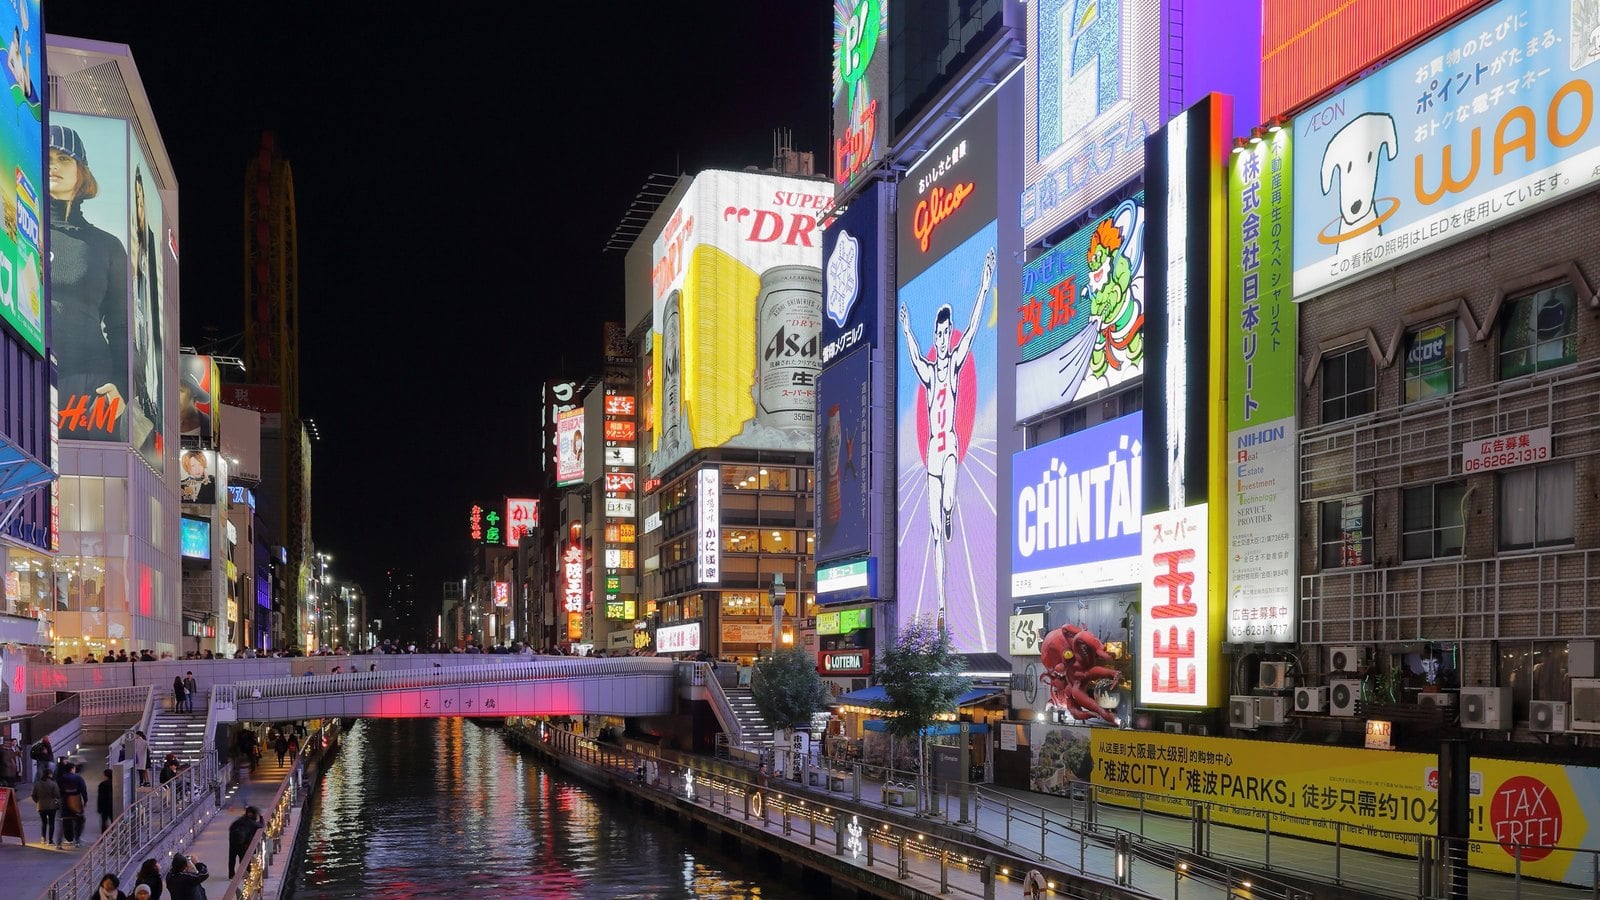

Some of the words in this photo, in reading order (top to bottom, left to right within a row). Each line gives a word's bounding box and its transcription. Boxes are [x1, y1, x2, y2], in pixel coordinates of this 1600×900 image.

[1415, 11, 1528, 84] お買物のたびに
[1416, 29, 1563, 114] ポイントがたまる、
[1415, 68, 1551, 142] おトクな電子マネー
[836, 100, 876, 184] ピップ
[919, 140, 967, 194] おいしさと健康
[914, 183, 974, 252] Glico
[1330, 173, 1570, 276] この看板の照明はLEDを使用しています。
[1270, 141, 1282, 351] 不動産再生のスペシャリスト
[1024, 252, 1071, 294] かぜに
[1242, 153, 1260, 420] 株式会社日本リート
[1017, 275, 1077, 346] 改源
[792, 371, 814, 386] 生
[58, 394, 120, 433] H&M
[937, 384, 947, 452] グリコ
[1238, 426, 1284, 448] NIHON
[1481, 434, 1530, 454] 広告募集
[1238, 450, 1258, 463] Real
[1238, 464, 1264, 477] Estate
[1466, 447, 1547, 471] 06-6262-1313
[1018, 436, 1142, 557] CHINTAI
[1237, 492, 1276, 505] Technology
[1238, 478, 1275, 492] Investment
[1238, 505, 1266, 517] SERVICE
[1238, 514, 1272, 526] PROVIDER
[1152, 518, 1197, 544] スーパー
[705, 527, 717, 578] かに道楽
[1151, 548, 1197, 693] 玉出
[1232, 606, 1288, 620] 広告主募集中
[832, 656, 861, 668] LOTTERIA
[424, 699, 495, 709] えびす橋
[1367, 722, 1390, 736] BAR
[1098, 742, 1233, 766] 从这里到大阪最大级别的购物中心
[1500, 786, 1547, 818] TAX
[1468, 842, 1484, 854] ree.
[1496, 817, 1559, 849] FREE!
